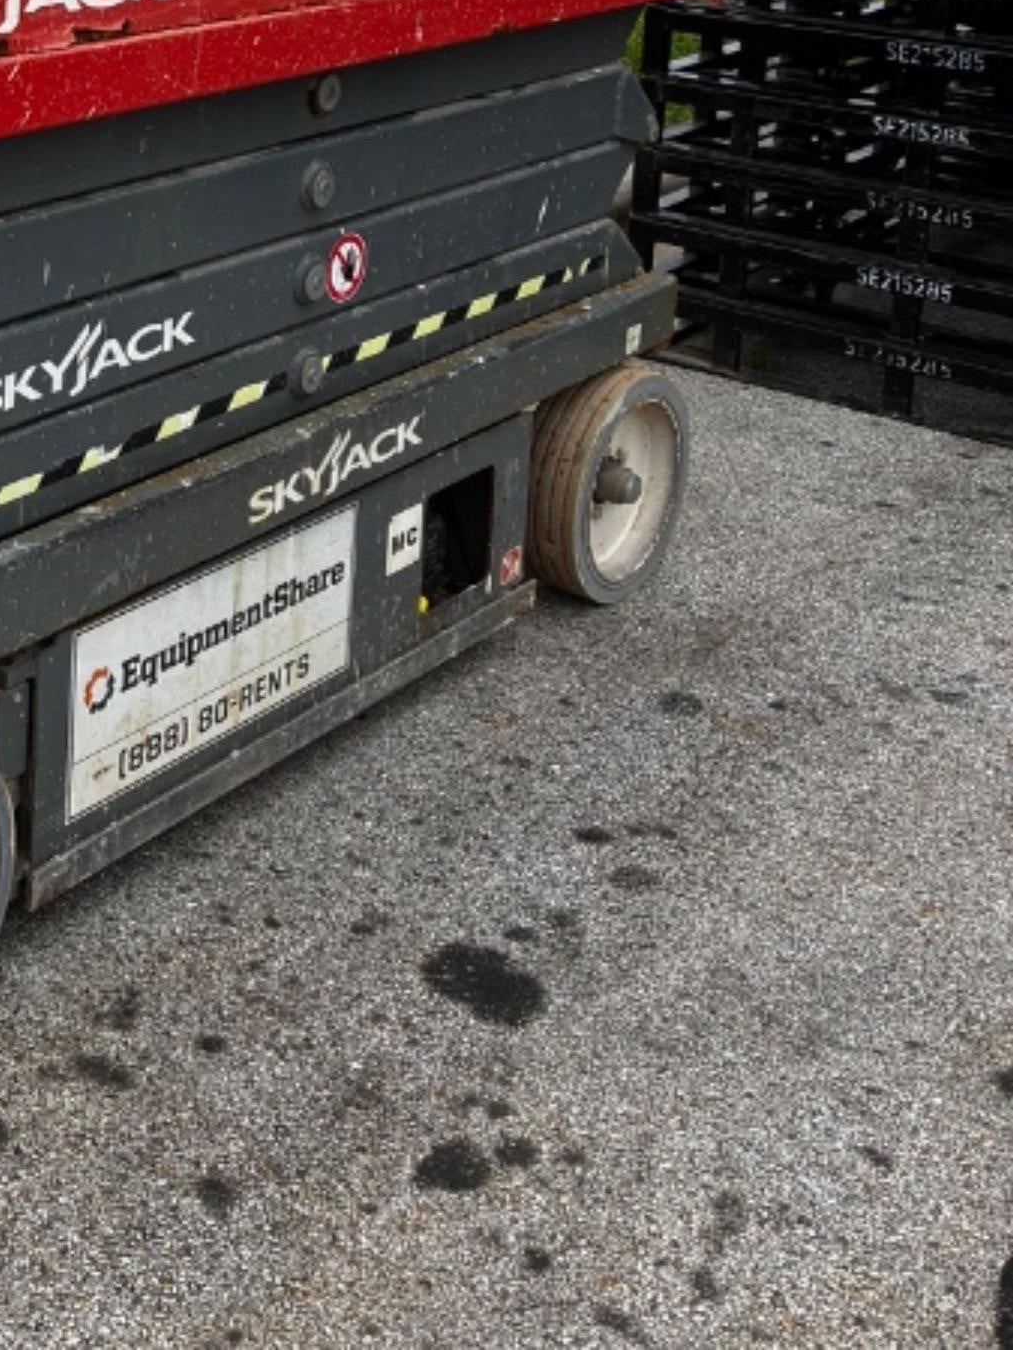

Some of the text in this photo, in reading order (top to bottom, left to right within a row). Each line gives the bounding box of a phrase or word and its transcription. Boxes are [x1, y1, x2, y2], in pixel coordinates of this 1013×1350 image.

[248, 416, 424, 525] SKYJACK
[120, 561, 346, 693] EquipmentShare
[118, 716, 190, 780] (888)
